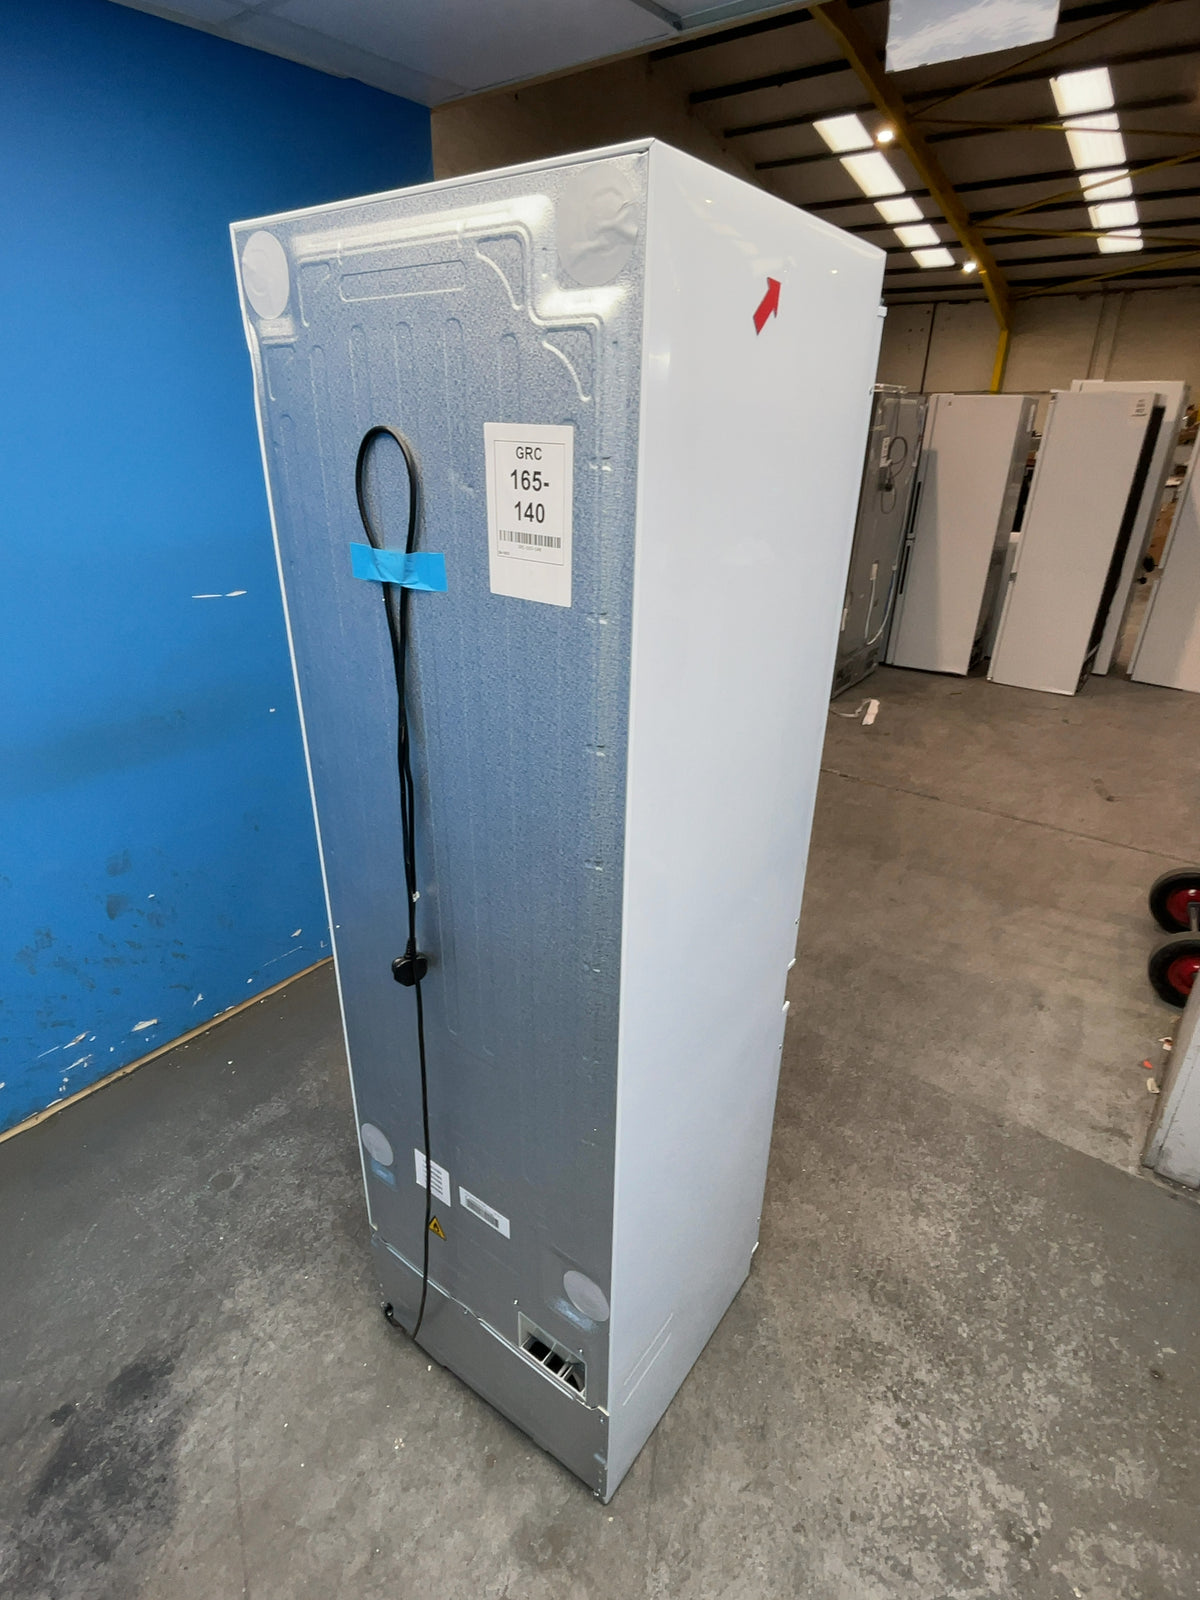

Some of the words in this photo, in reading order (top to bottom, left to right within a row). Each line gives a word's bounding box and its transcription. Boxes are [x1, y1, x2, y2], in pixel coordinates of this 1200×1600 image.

[515, 446, 542, 461] GRC
[510, 469, 550, 492] 165-
[514, 501, 545, 524] 140
